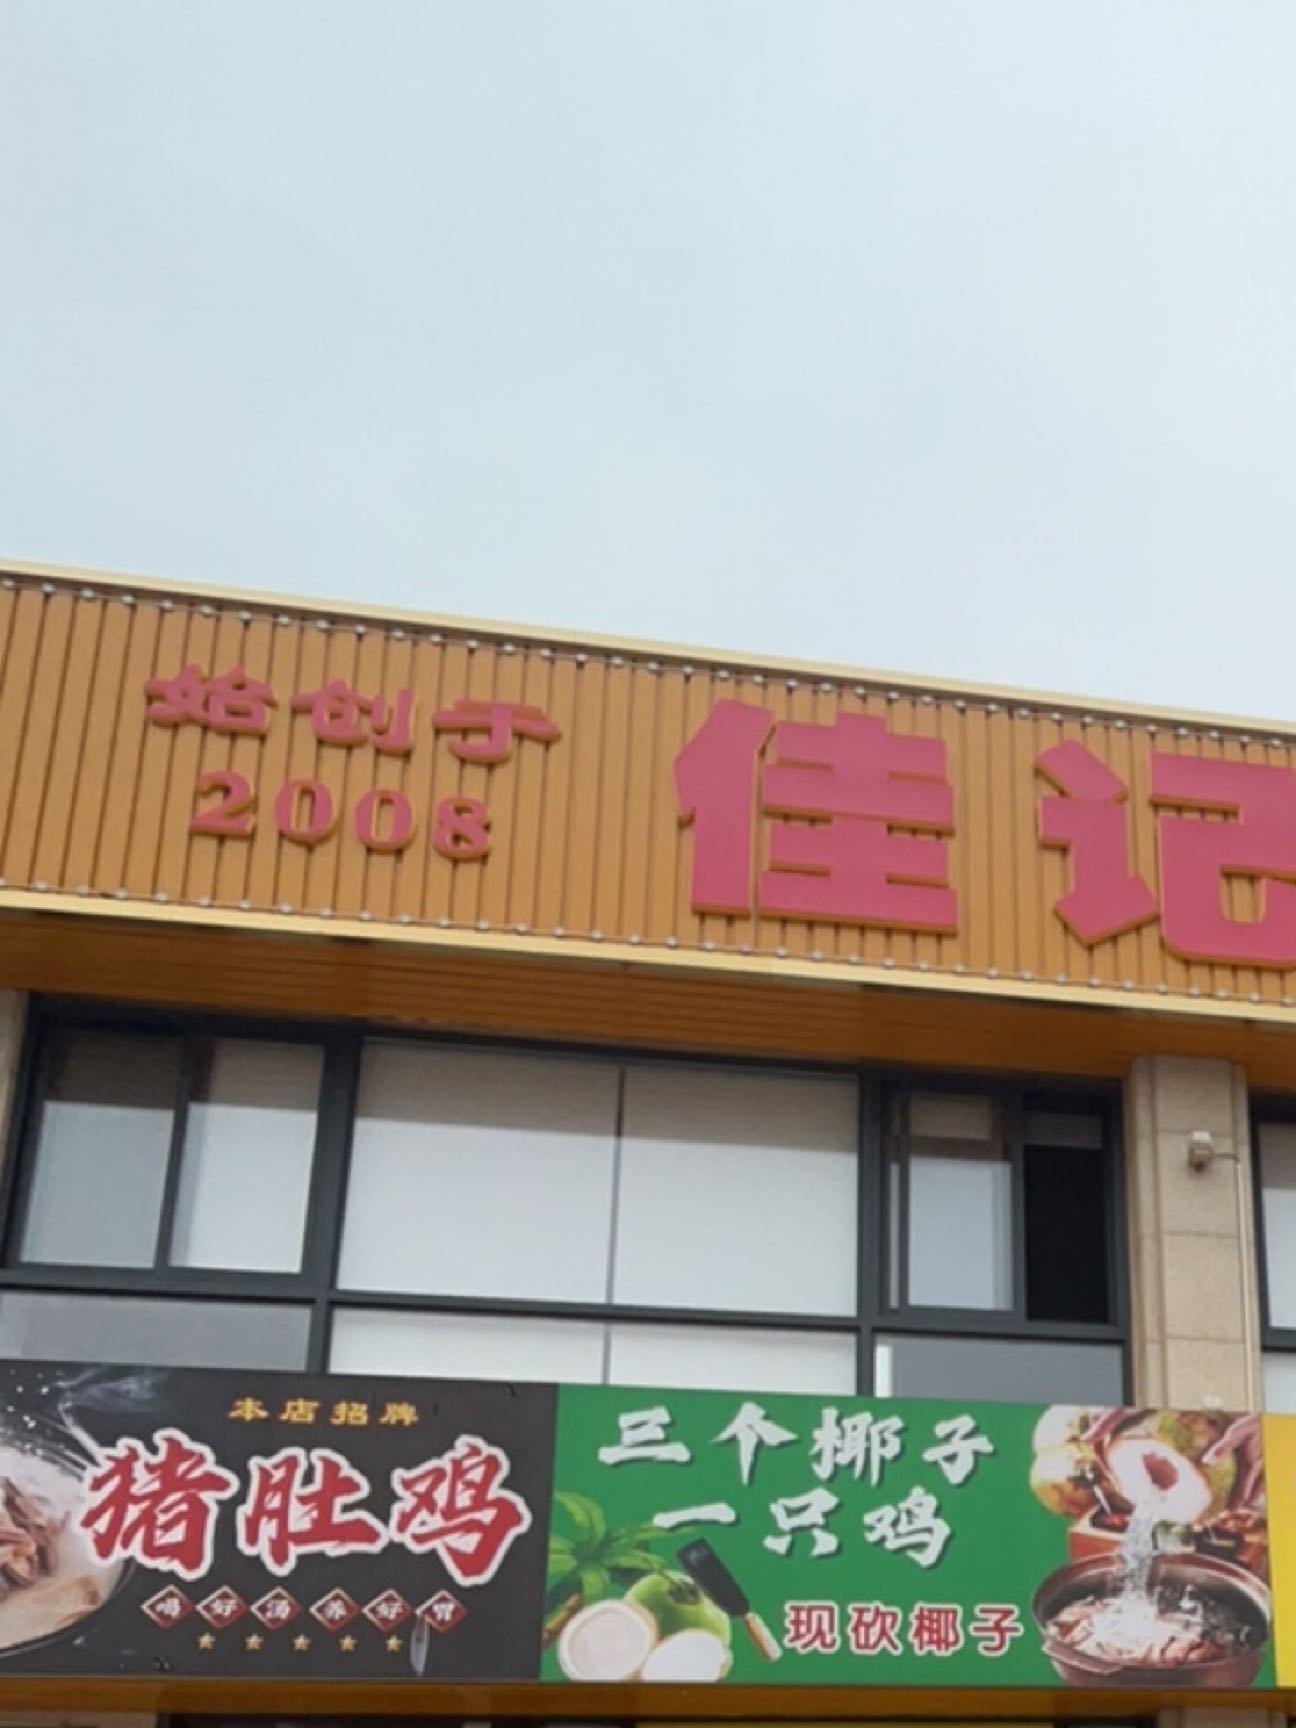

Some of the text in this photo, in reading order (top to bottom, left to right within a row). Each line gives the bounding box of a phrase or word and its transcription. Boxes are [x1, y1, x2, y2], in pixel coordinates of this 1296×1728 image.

[144, 664, 563, 764] 始创于
[189, 770, 494, 862] 2008
[228, 1396, 420, 1426] 本店招牌
[598, 1400, 996, 1487] 三个椰子
[78, 1431, 530, 1584] 猪肚鸡
[653, 1486, 952, 1567] 一只鸡
[784, 1602, 1026, 1656] 现砍椰子
